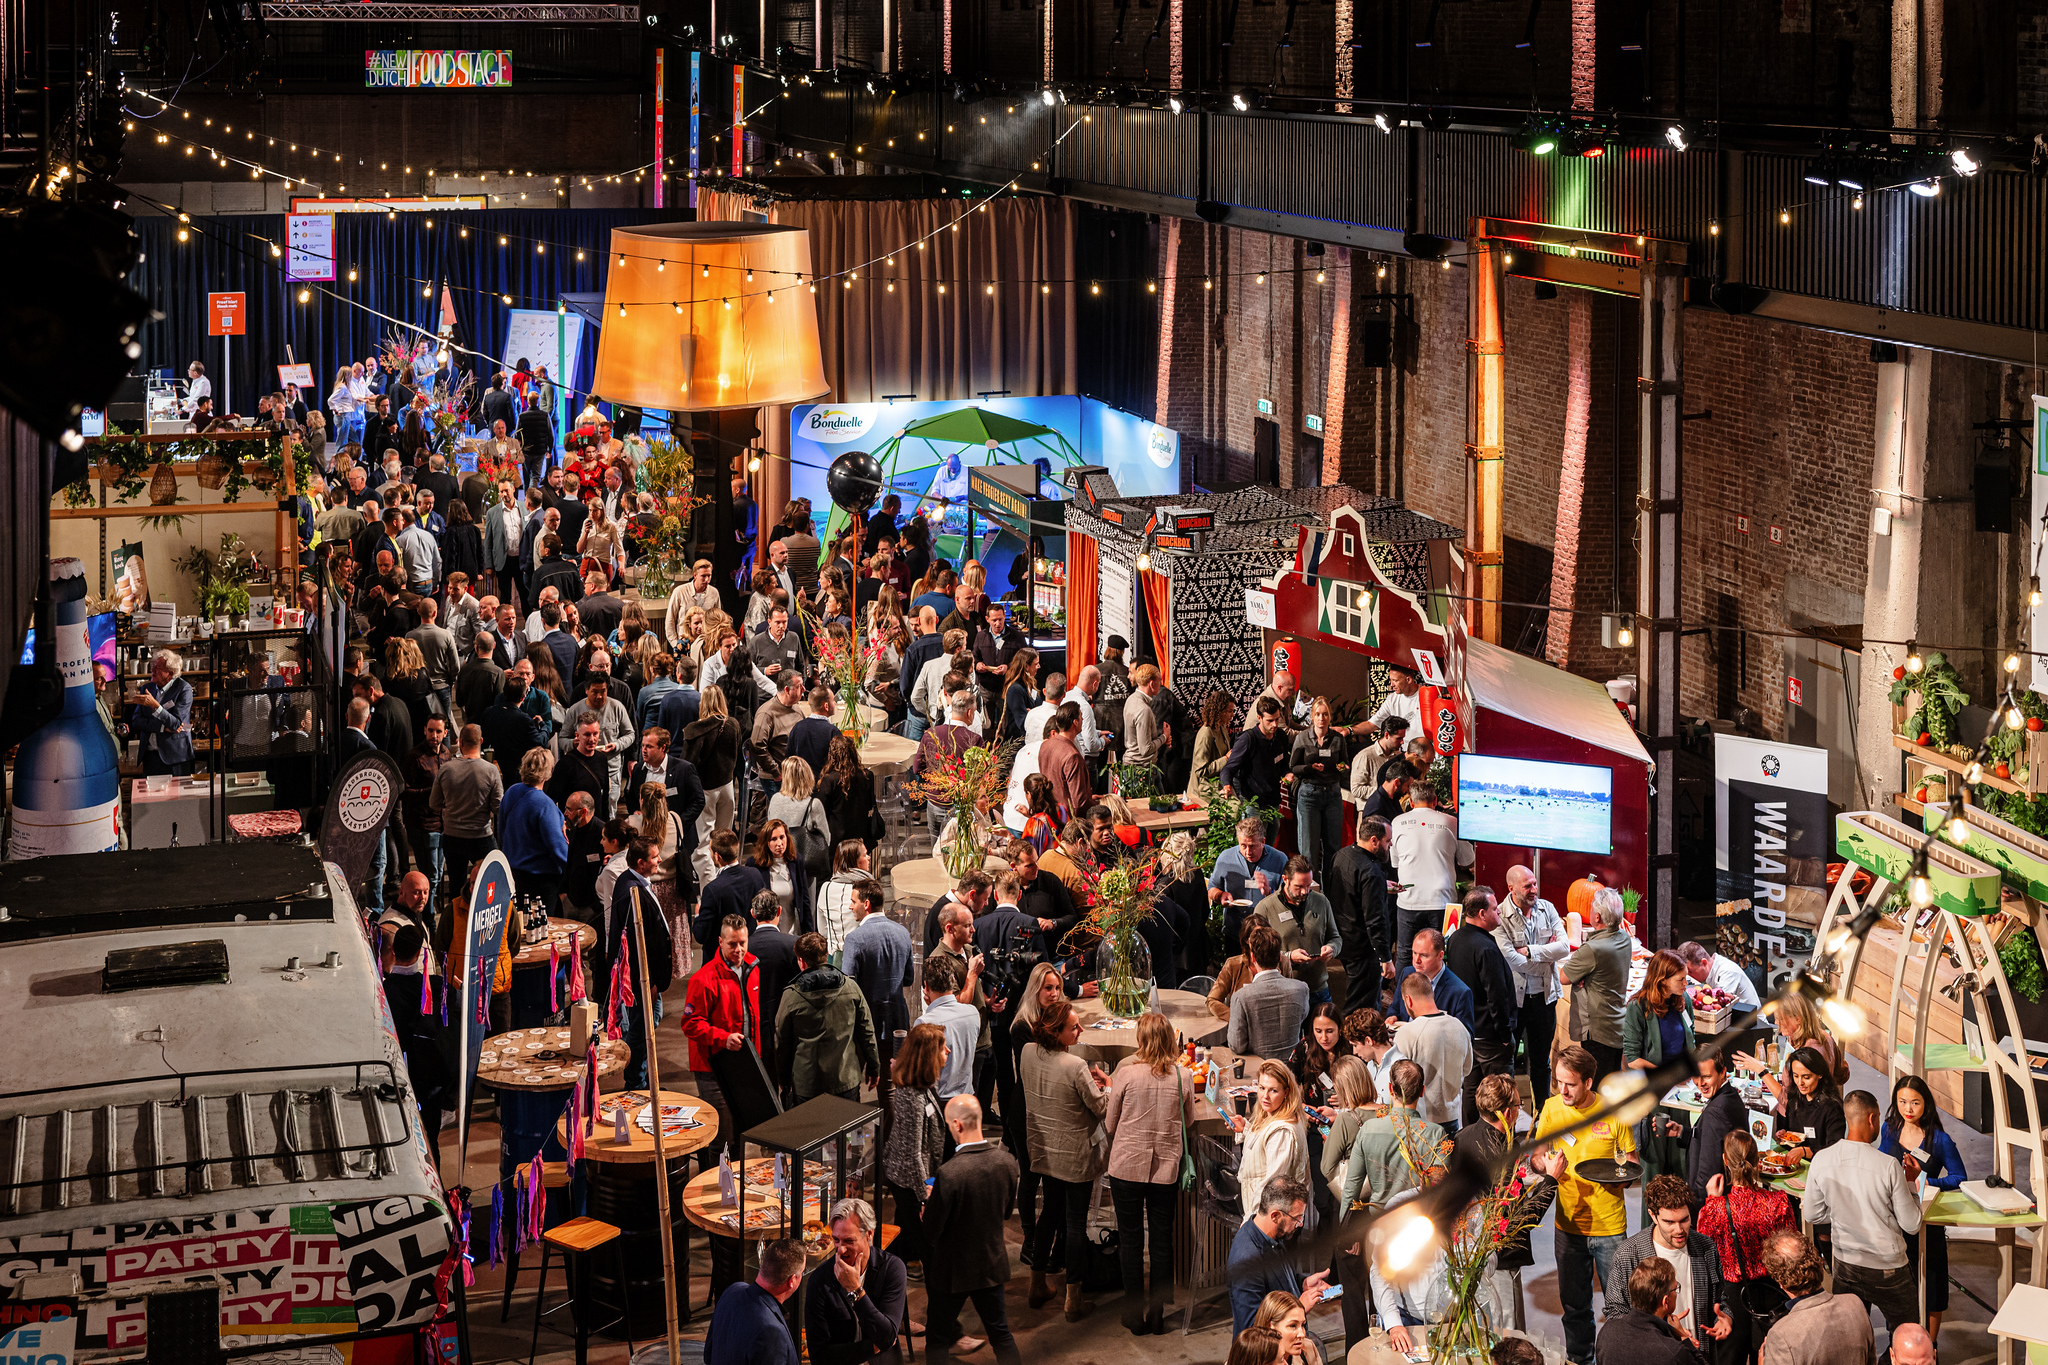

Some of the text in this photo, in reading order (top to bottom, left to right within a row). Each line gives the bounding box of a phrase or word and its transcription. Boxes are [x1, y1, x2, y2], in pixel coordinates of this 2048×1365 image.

[368, 53, 406, 68] #NEW
[412, 52, 510, 86] FOOD STAGE
[369, 70, 406, 86] DUTCH
[810, 413, 862, 430] Bonduelle
[1178, 517, 1210, 529] SNACKBOX
[1156, 538, 1190, 548] SNACKBOX
[1250, 600, 1264, 610] YAMA
[342, 808, 384, 830] MAASTRICHT
[1754, 802, 1787, 954] WAARDE
[474, 904, 503, 932] MERGEL
[115, 1232, 284, 1277] PARTY
